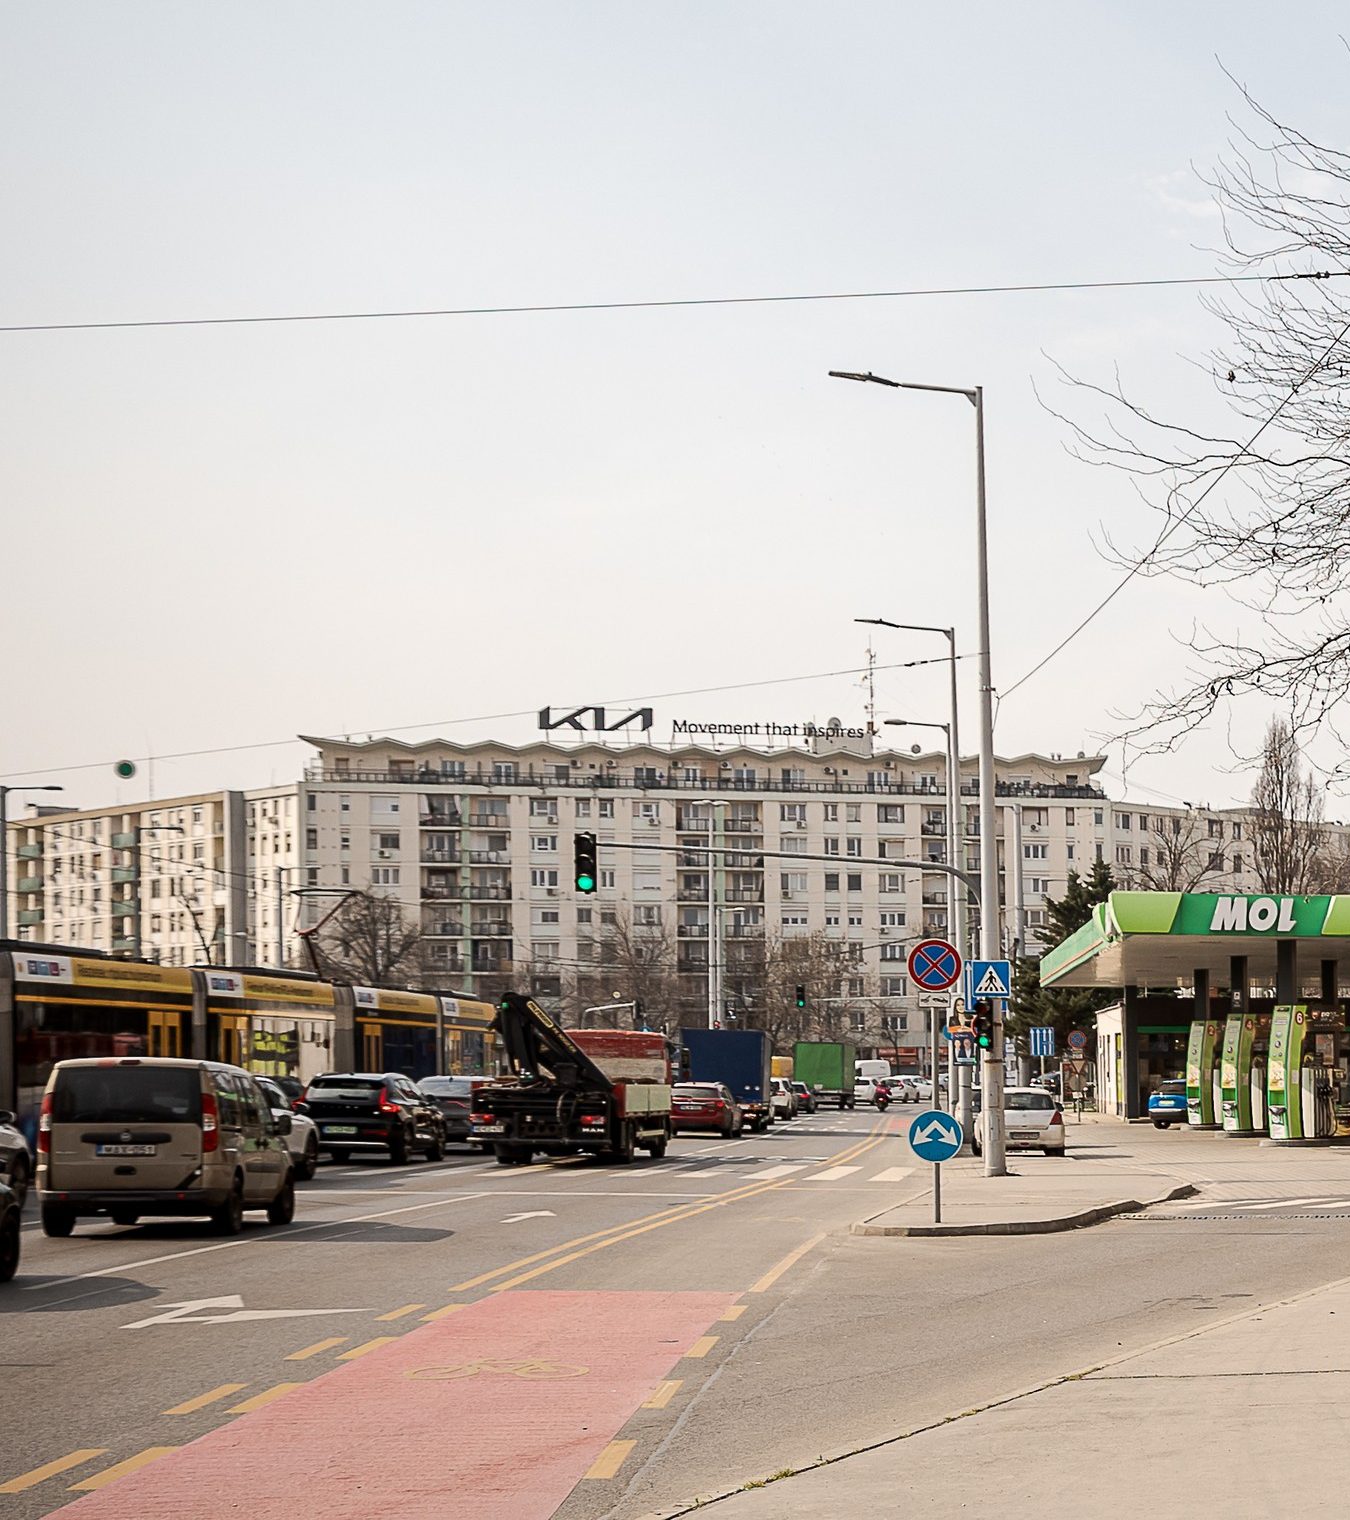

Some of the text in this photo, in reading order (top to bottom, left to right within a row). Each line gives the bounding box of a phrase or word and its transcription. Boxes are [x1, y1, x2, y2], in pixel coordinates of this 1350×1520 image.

[538, 706, 653, 732] KIA
[672, 719, 864, 740] Movement that inspires
[1209, 896, 1297, 932] MOL
[1296, 1012, 1303, 1024] 6
